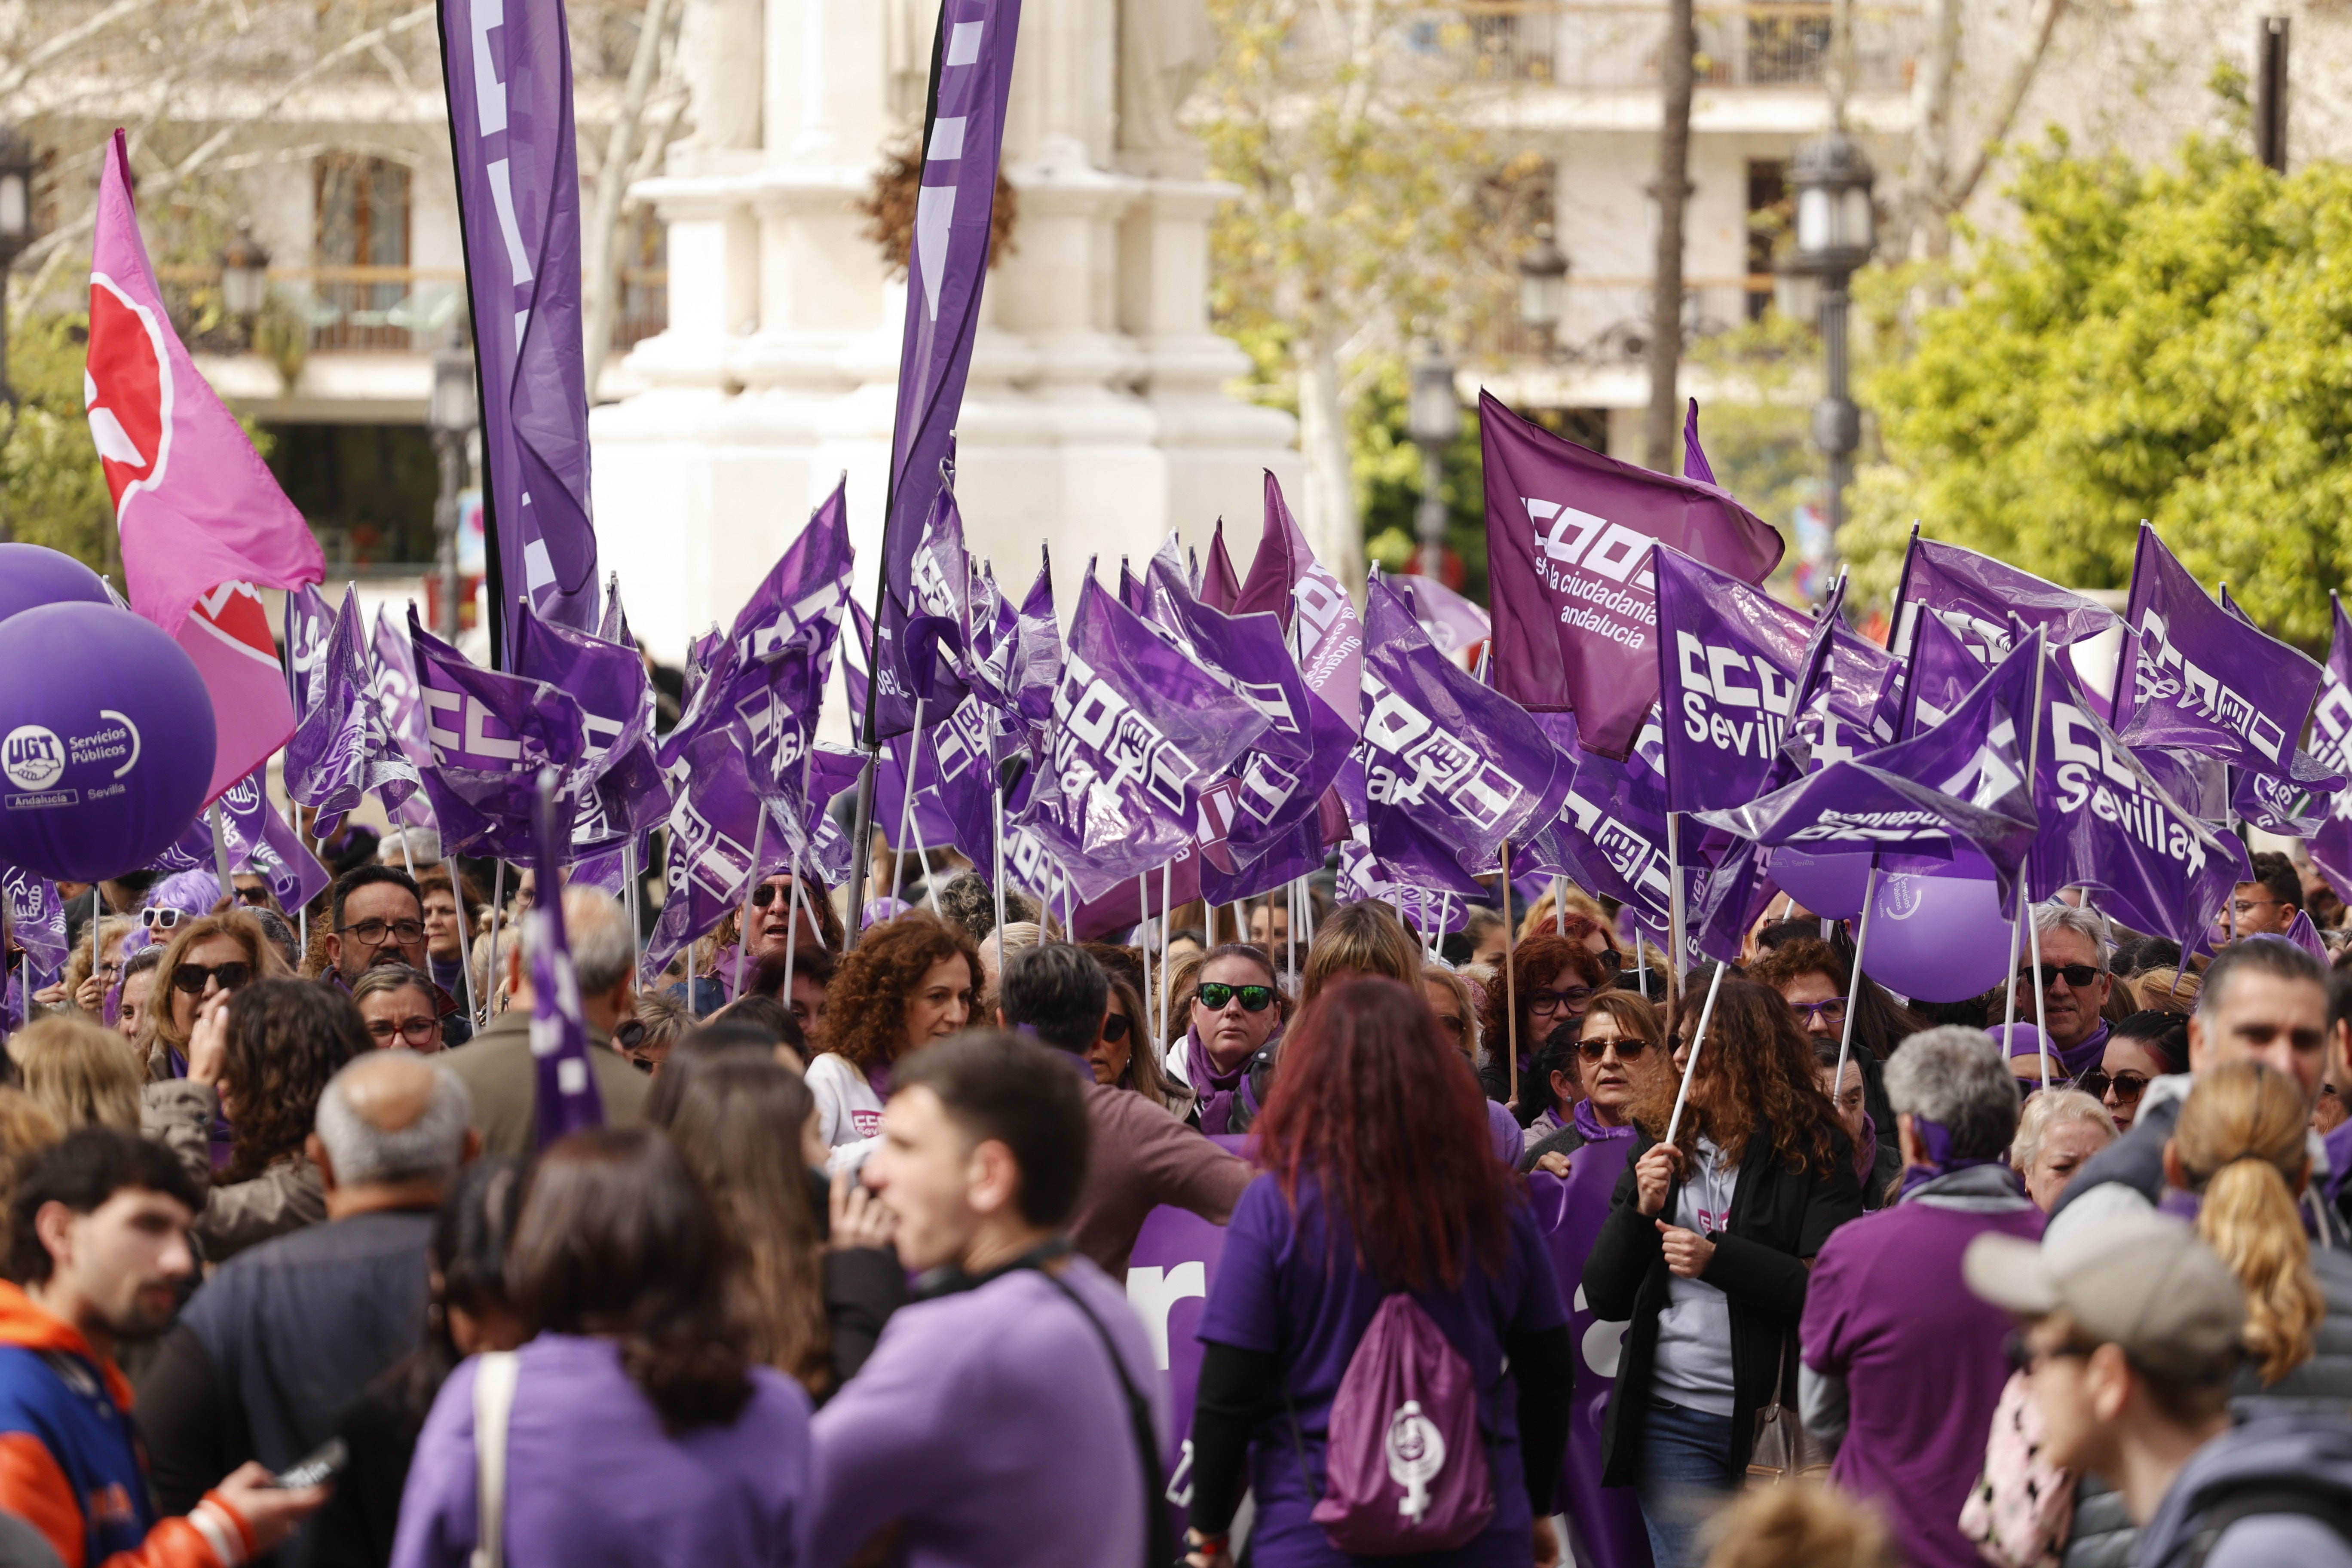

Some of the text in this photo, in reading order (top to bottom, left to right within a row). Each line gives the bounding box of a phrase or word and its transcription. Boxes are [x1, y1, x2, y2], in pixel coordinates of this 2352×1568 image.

[1549, 564, 1559, 590] la
[1560, 571, 1657, 626] ciudadanía
[1561, 605, 1645, 649] andalucía
[69, 727, 128, 751] Servicios
[1683, 691, 1784, 761] Sevill
[9, 735, 55, 764] UGT
[71, 744, 127, 765] Públicos
[15, 793, 68, 807] Andalucía
[87, 783, 126, 800] Sevilla
[2056, 763, 2190, 860] Sevilla
[1894, 882, 1902, 910] Públicos
[1901, 877, 1911, 909] Servicios
